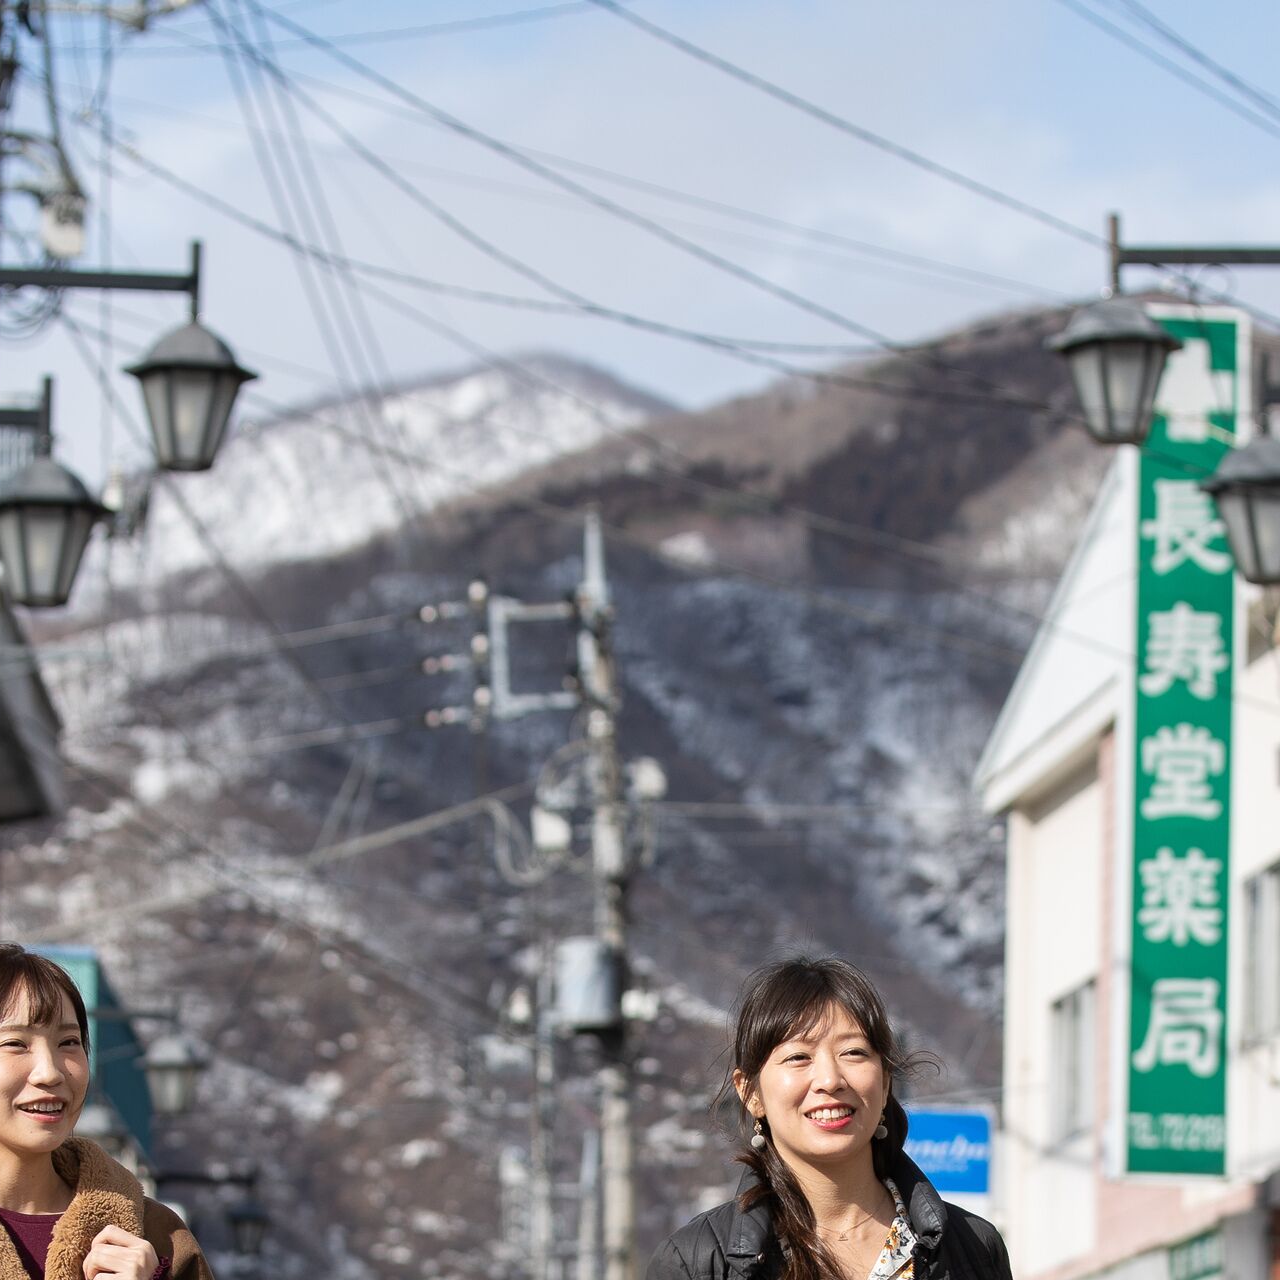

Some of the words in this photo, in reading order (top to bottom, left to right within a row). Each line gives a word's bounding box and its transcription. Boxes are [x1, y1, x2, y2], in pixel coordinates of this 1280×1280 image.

[1132, 480, 1232, 1077] 長寿堂薬局
